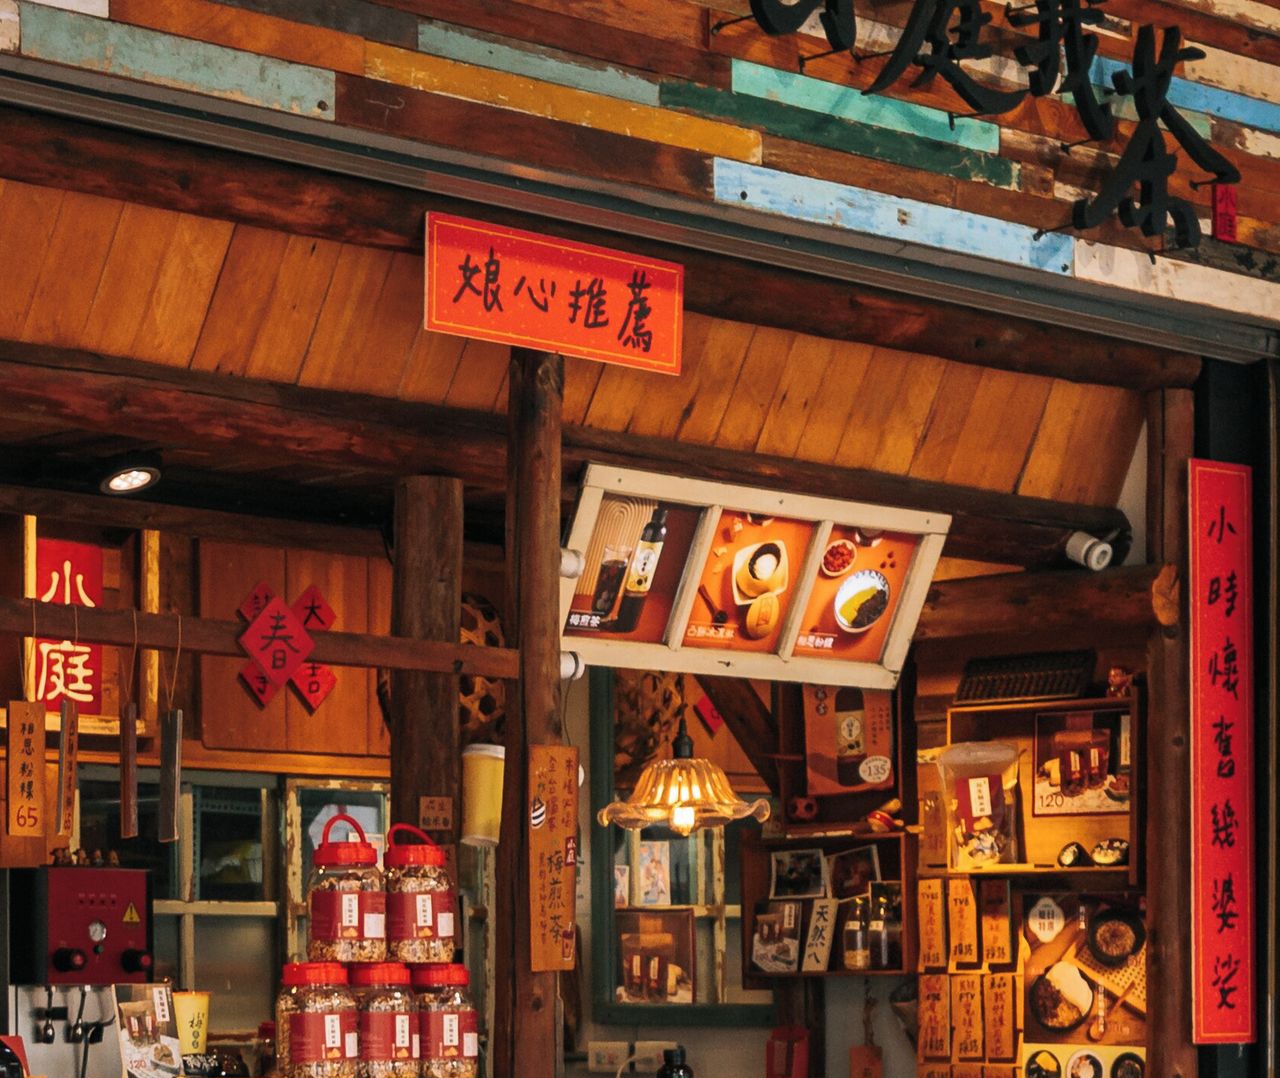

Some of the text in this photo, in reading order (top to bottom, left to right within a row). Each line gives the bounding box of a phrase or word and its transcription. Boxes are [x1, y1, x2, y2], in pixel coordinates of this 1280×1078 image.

[452, 246, 653, 353] 娘心推薦
[303, 598, 325, 626] 大
[36, 559, 97, 703] 小庭
[260, 611, 301, 670] 春
[867, 762, 887, 778] 135
[1038, 793, 1064, 809] 120
[16, 805, 38, 828] 65
